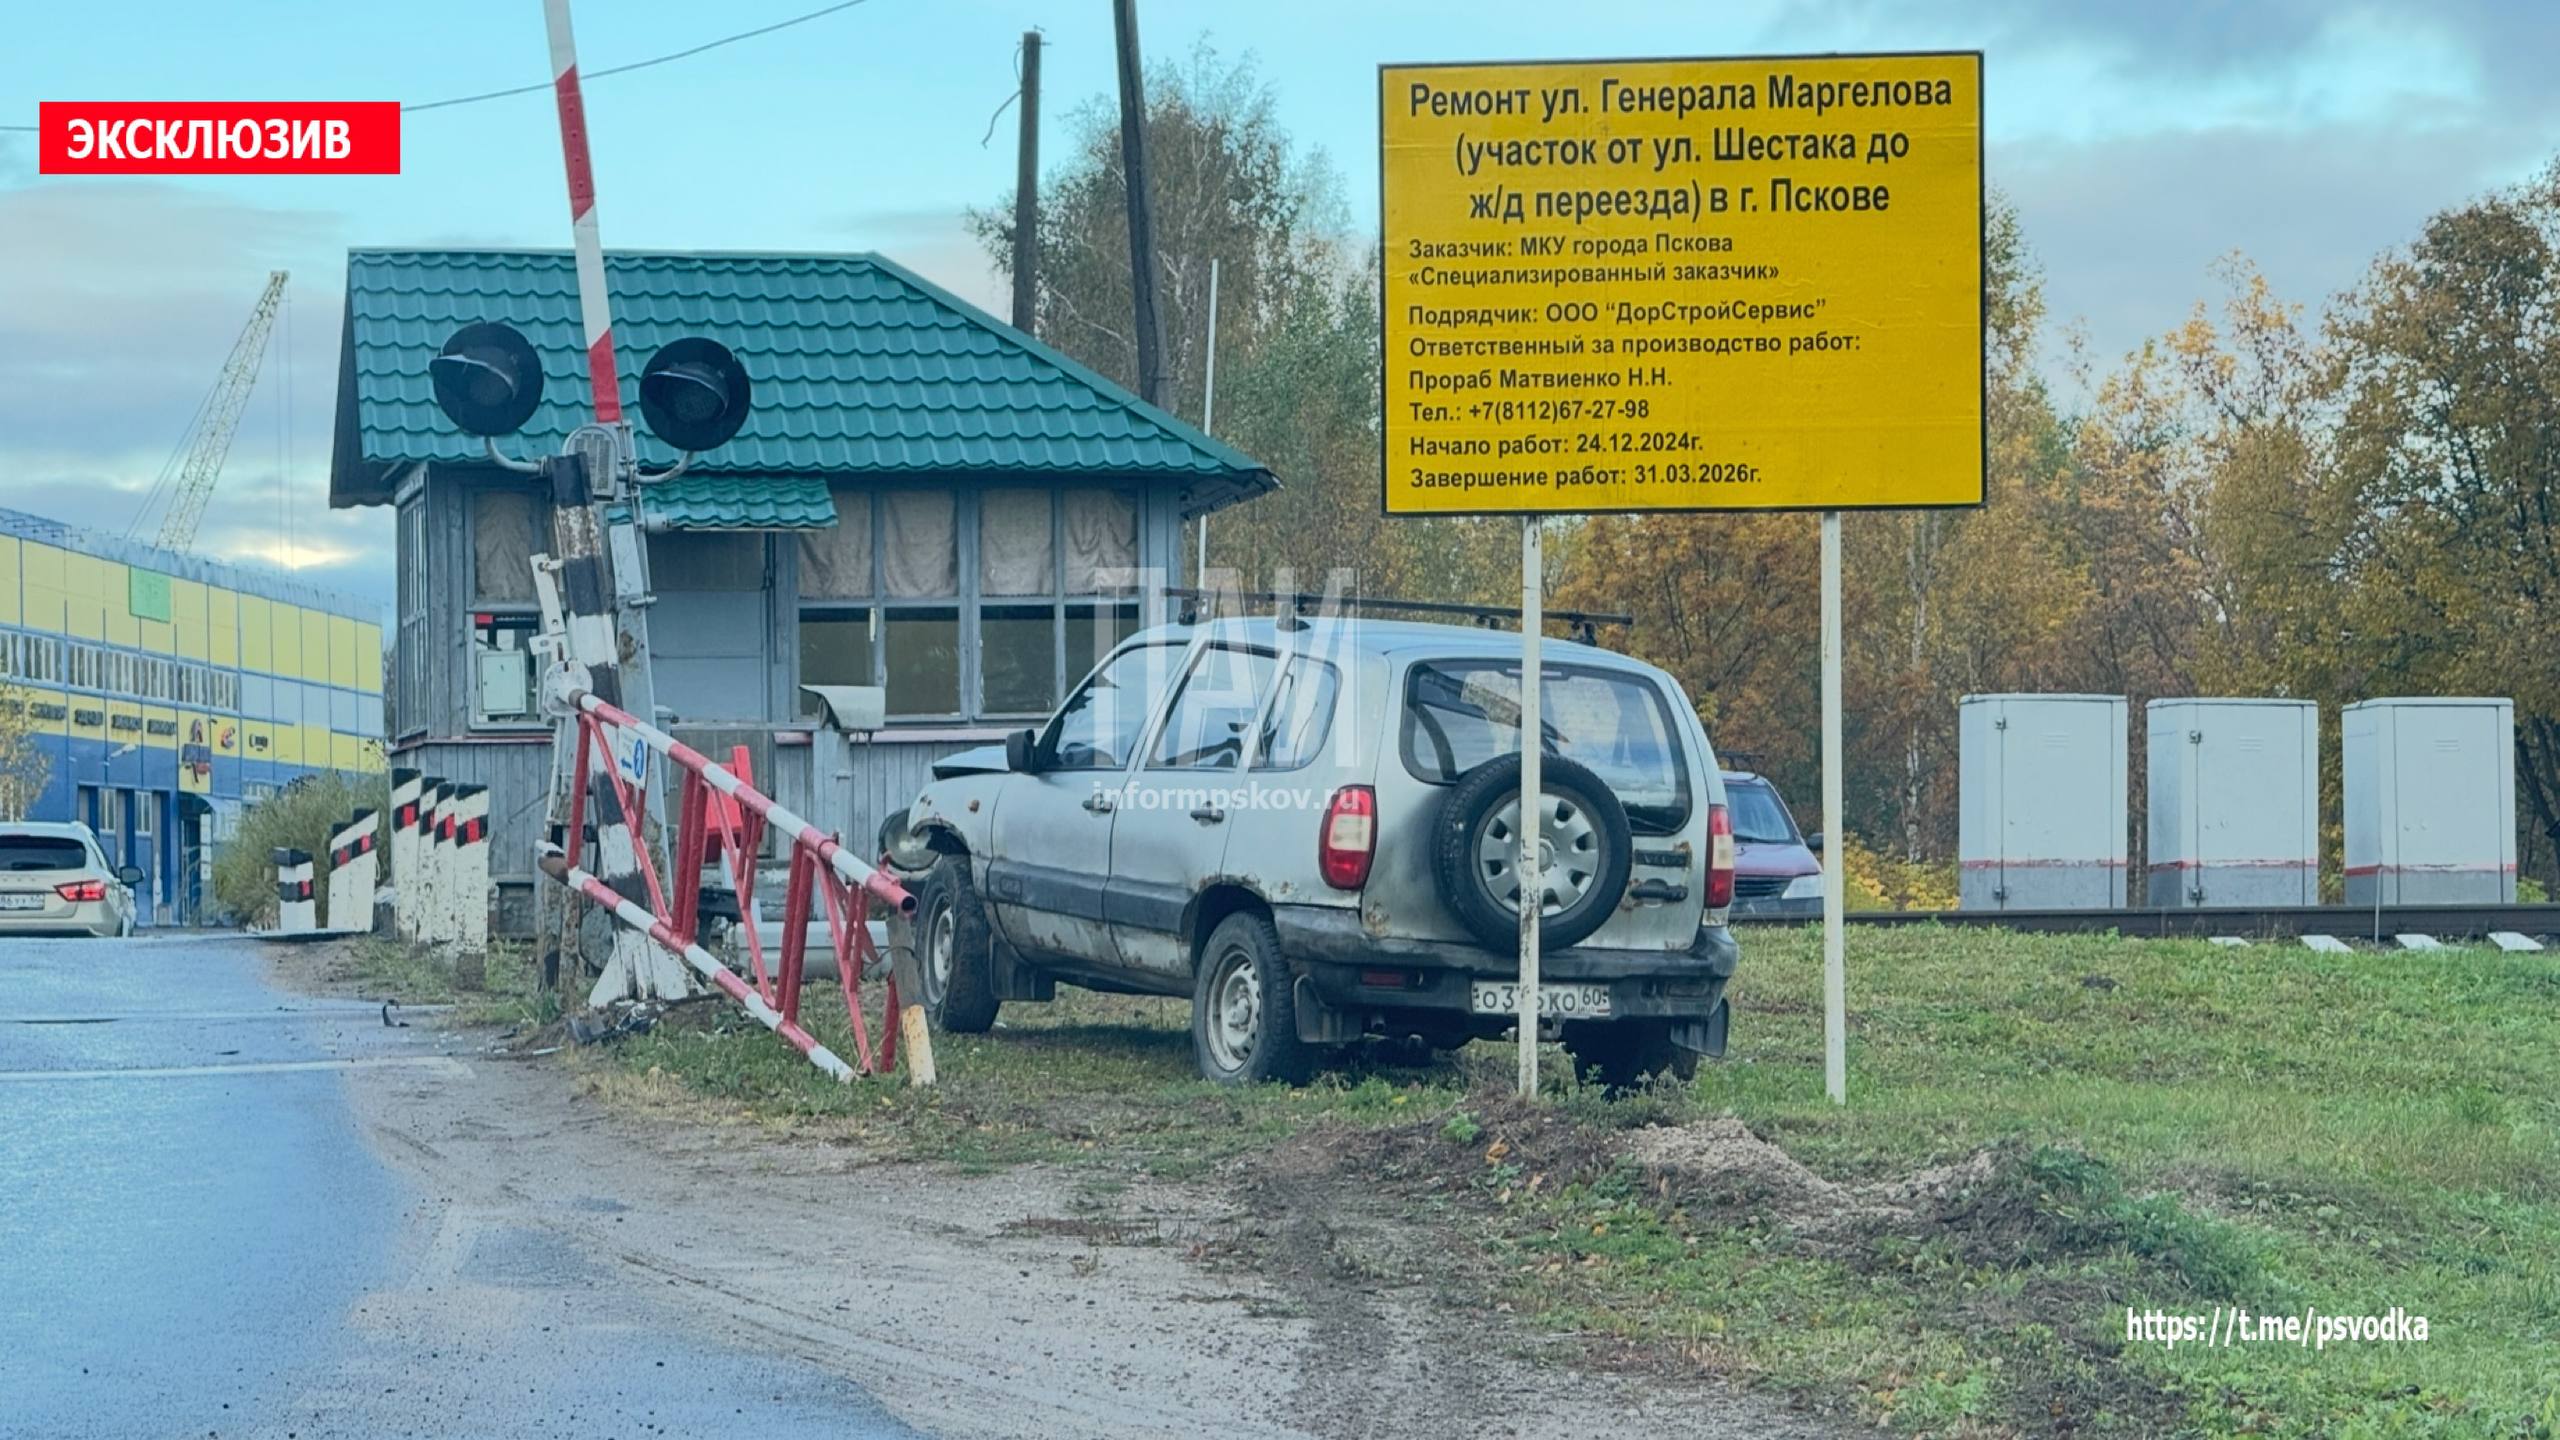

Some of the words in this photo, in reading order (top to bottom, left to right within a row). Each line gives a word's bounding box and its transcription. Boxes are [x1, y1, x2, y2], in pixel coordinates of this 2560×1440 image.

[1410, 82, 1531, 117] Ремонт
[1540, 88, 1589, 124] ул.
[1602, 78, 1756, 121] Генерала
[1768, 74, 1952, 117] Маргелова
[1456, 132, 1597, 176] (участок
[1607, 138, 1643, 165] от
[1652, 137, 1701, 173] ул.
[1713, 126, 1857, 162] Шестака
[1866, 132, 1910, 165] до
[1469, 184, 1525, 225] ж/д
[1535, 179, 1701, 225] переезда)
[1710, 187, 1729, 213] в
[1740, 187, 1758, 213] г.
[1770, 177, 1890, 213] Пскове
[1409, 238, 1512, 259] Заказчик:
[1520, 236, 1566, 256] МКУ
[1573, 238, 1648, 259] города
[1655, 233, 1733, 253] Пскова
[1409, 262, 1666, 288] «Специализированный
[1673, 265, 1779, 281] заказчик»
[1409, 305, 1537, 329] Подрядчик:
[1546, 302, 1598, 323] ООО
[1409, 335, 1584, 357] Ответственный
[1592, 338, 1615, 354] за
[1622, 337, 1782, 358] производство
[1789, 330, 1860, 356] работ:
[1409, 368, 1492, 394] Прораб
[1499, 368, 1621, 389] Матвиенко
[1628, 366, 1672, 386] Н.Н.
[1409, 402, 1461, 422] Тел.:
[1469, 399, 1650, 425] +7(8112)67-27-98
[1410, 436, 1491, 456] Начало
[1498, 433, 1569, 459] работ:
[1576, 431, 1703, 453] 24.12.2024г.
[1410, 468, 1548, 492] Завершение
[1556, 465, 1626, 490] работ:
[1634, 463, 1761, 484] 31.03.2026г.
